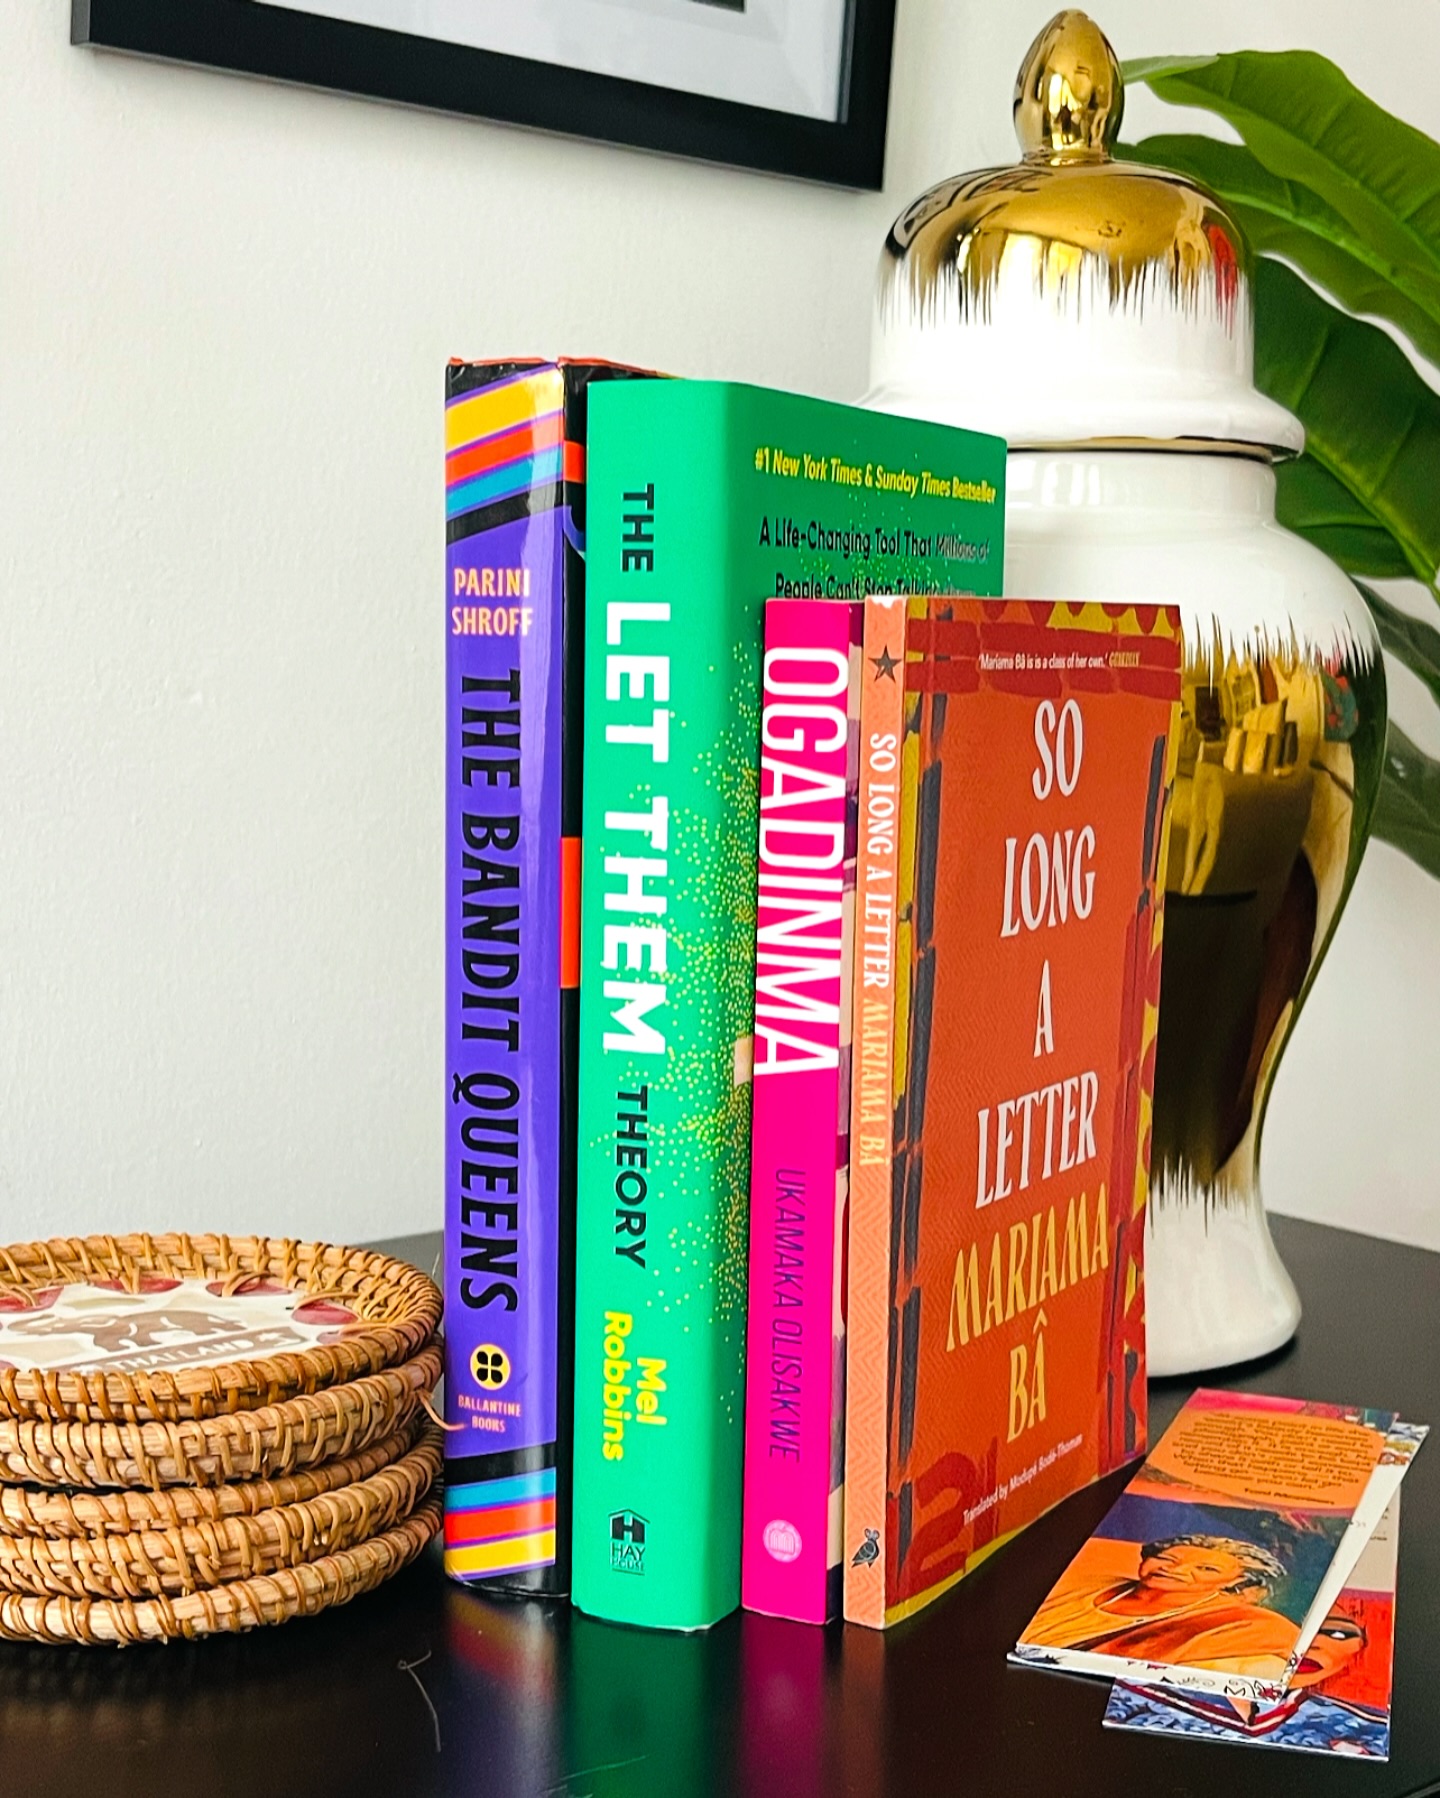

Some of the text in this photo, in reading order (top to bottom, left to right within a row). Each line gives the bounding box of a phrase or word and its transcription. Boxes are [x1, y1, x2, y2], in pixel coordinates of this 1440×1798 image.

[755, 447, 997, 505] #1 New York Times & Sunday Times Bestseller
[759, 516, 771, 547] A
[775, 518, 871, 561] Life-Changing
[875, 527, 900, 557] Tool
[903, 529, 932, 557] That
[452, 606, 534, 636] SHROFF
[453, 567, 530, 598] PARINI
[1075, 652, 1088, 669] her
[869, 732, 897, 772] SO
[1032, 698, 1084, 801] SO
[867, 783, 895, 855] LONG
[602, 483, 672, 1269] THE LET THEM THEORY
[752, 646, 849, 1077] OGADINMA
[867, 865, 892, 881] A
[1000, 824, 1096, 938] LONG
[863, 893, 892, 989] LETTER
[452, 668, 521, 1312] THE BANDIT QUEENS
[1033, 959, 1054, 1058] A
[860, 998, 889, 1123] MARIAMA
[975, 1070, 1099, 1210] LETTER
[946, 1182, 1109, 1353] MARIAMA
[769, 1169, 806, 1464] UKAMAKA OLISAKWE
[458, 1394, 521, 1418] BALLANTINE
[602, 1311, 633, 1461] Robbins
[635, 1357, 667, 1426] Mel
[1007, 1307, 1048, 1444] BÂ
[472, 1415, 506, 1433] BOOKS
[963, 1484, 998, 1526] Translated
[999, 1483, 1008, 1501] by
[612, 1542, 646, 1562] HAY
